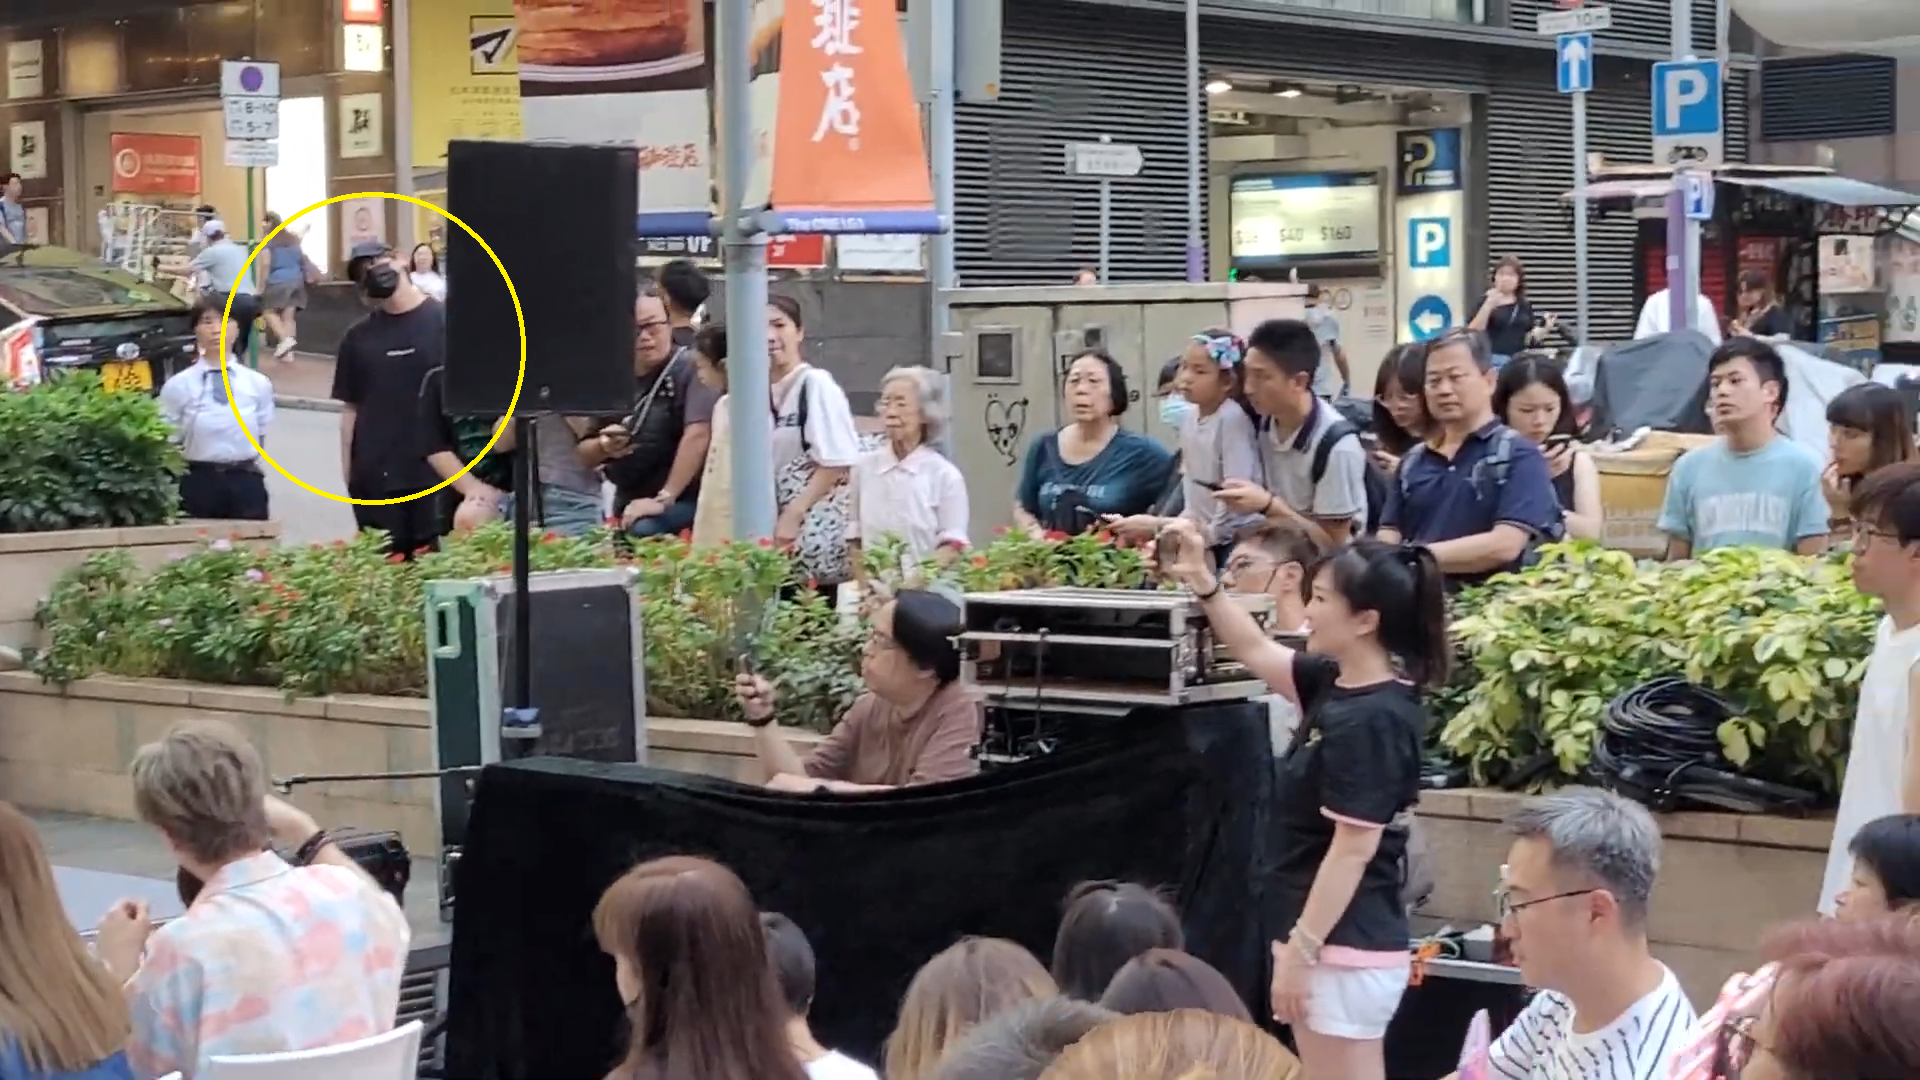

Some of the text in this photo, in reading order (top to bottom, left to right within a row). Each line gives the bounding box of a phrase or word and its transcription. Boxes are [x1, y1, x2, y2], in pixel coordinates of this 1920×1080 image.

[1665, 69, 1708, 129] P
[1321, 225, 1353, 241] $160
[1417, 223, 1446, 264] P
